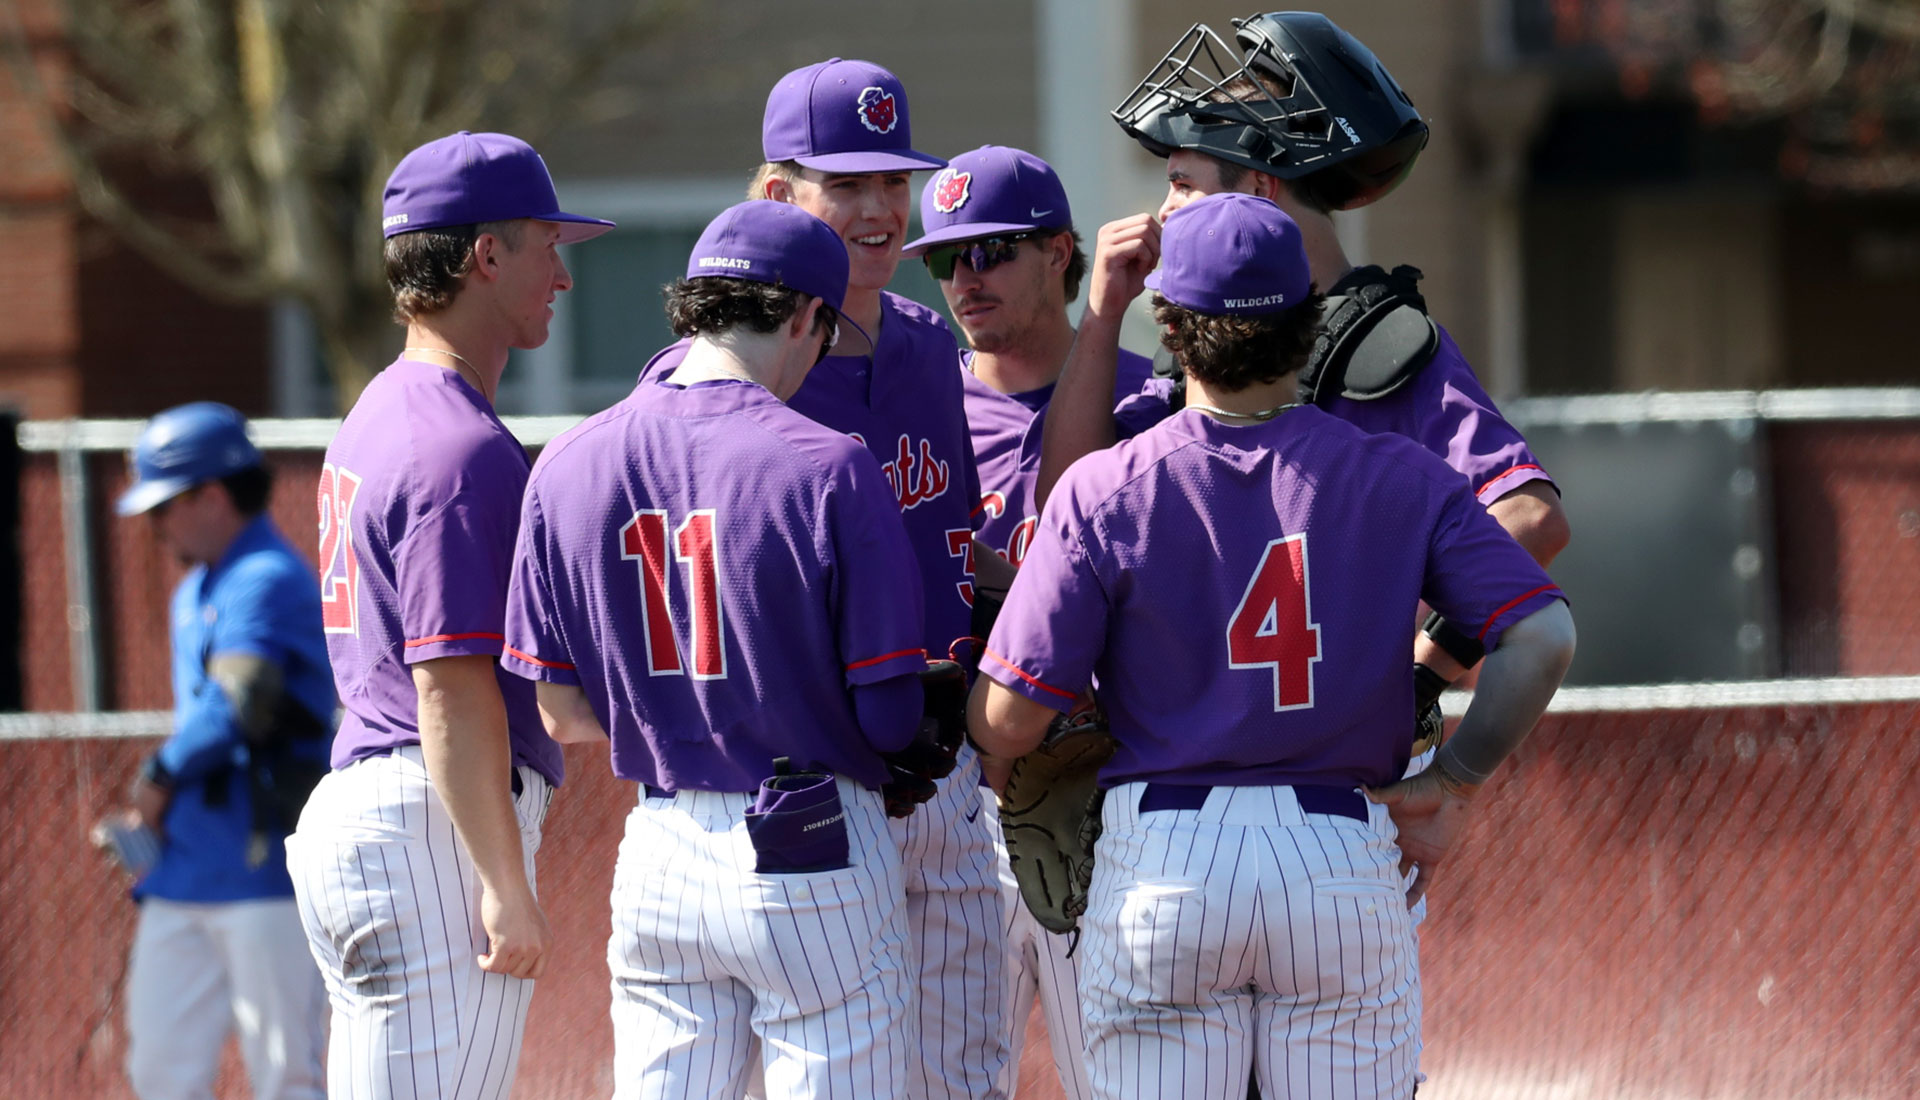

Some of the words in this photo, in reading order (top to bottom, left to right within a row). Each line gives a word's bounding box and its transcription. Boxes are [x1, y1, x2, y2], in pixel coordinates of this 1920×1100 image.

[699, 257, 751, 270] WILDCATS
[1224, 294, 1284, 308] WILDCATS
[619, 508, 727, 680] 11
[1226, 532, 1322, 712] 4
